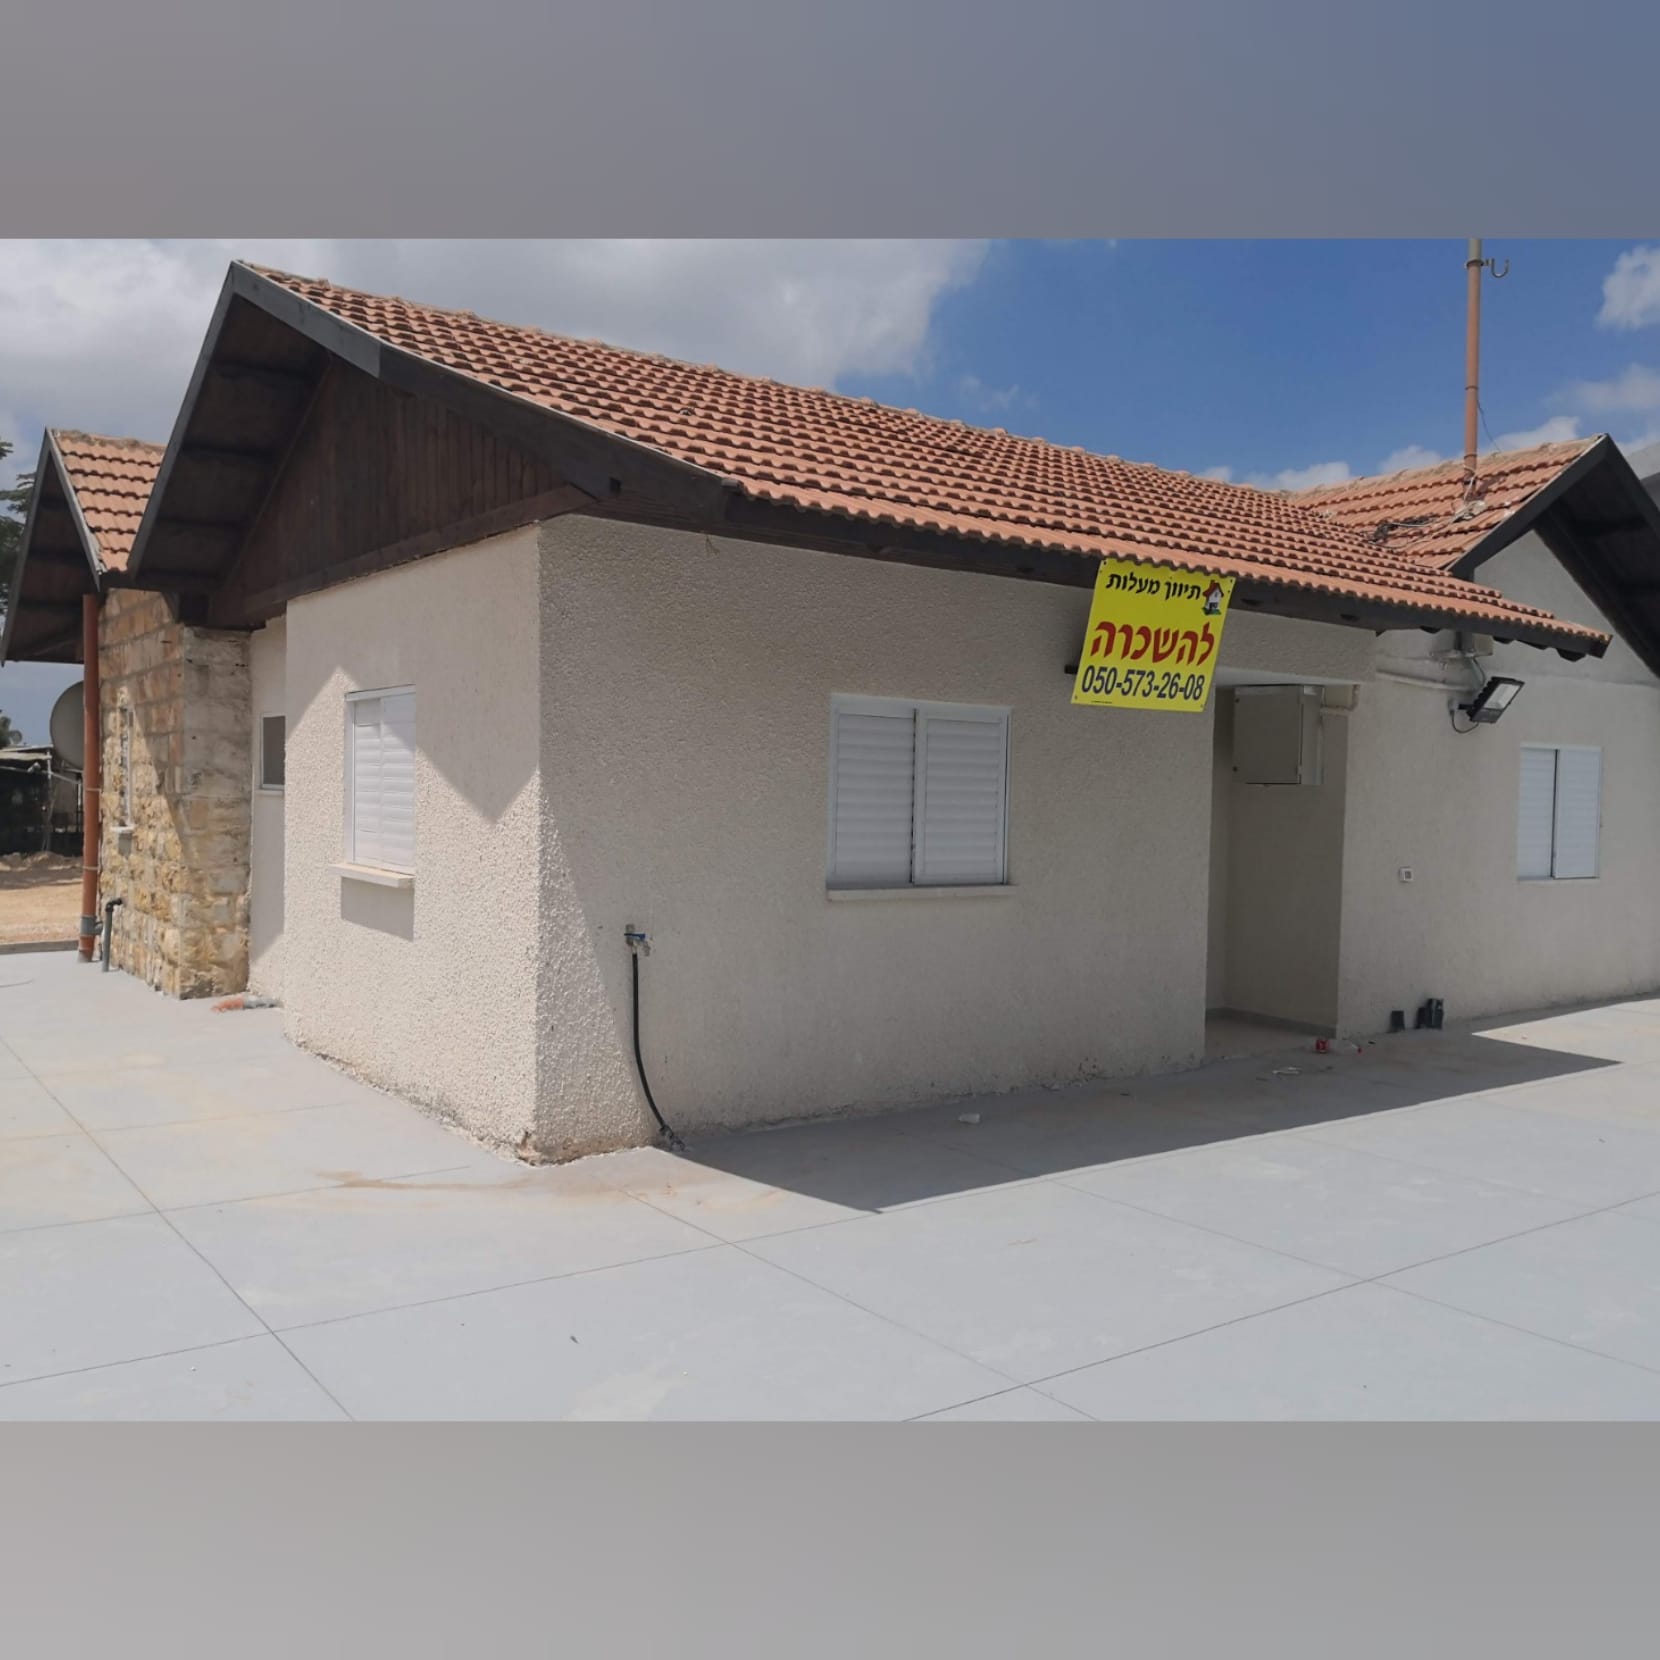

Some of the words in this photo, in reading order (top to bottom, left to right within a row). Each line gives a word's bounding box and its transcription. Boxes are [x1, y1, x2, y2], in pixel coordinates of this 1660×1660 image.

[1105, 572, 1160, 594] מעלות
[1164, 581, 1201, 600] תיווך
[1090, 621, 1215, 666] להשכרה
[1081, 665, 1205, 700] 050-573-26-08
